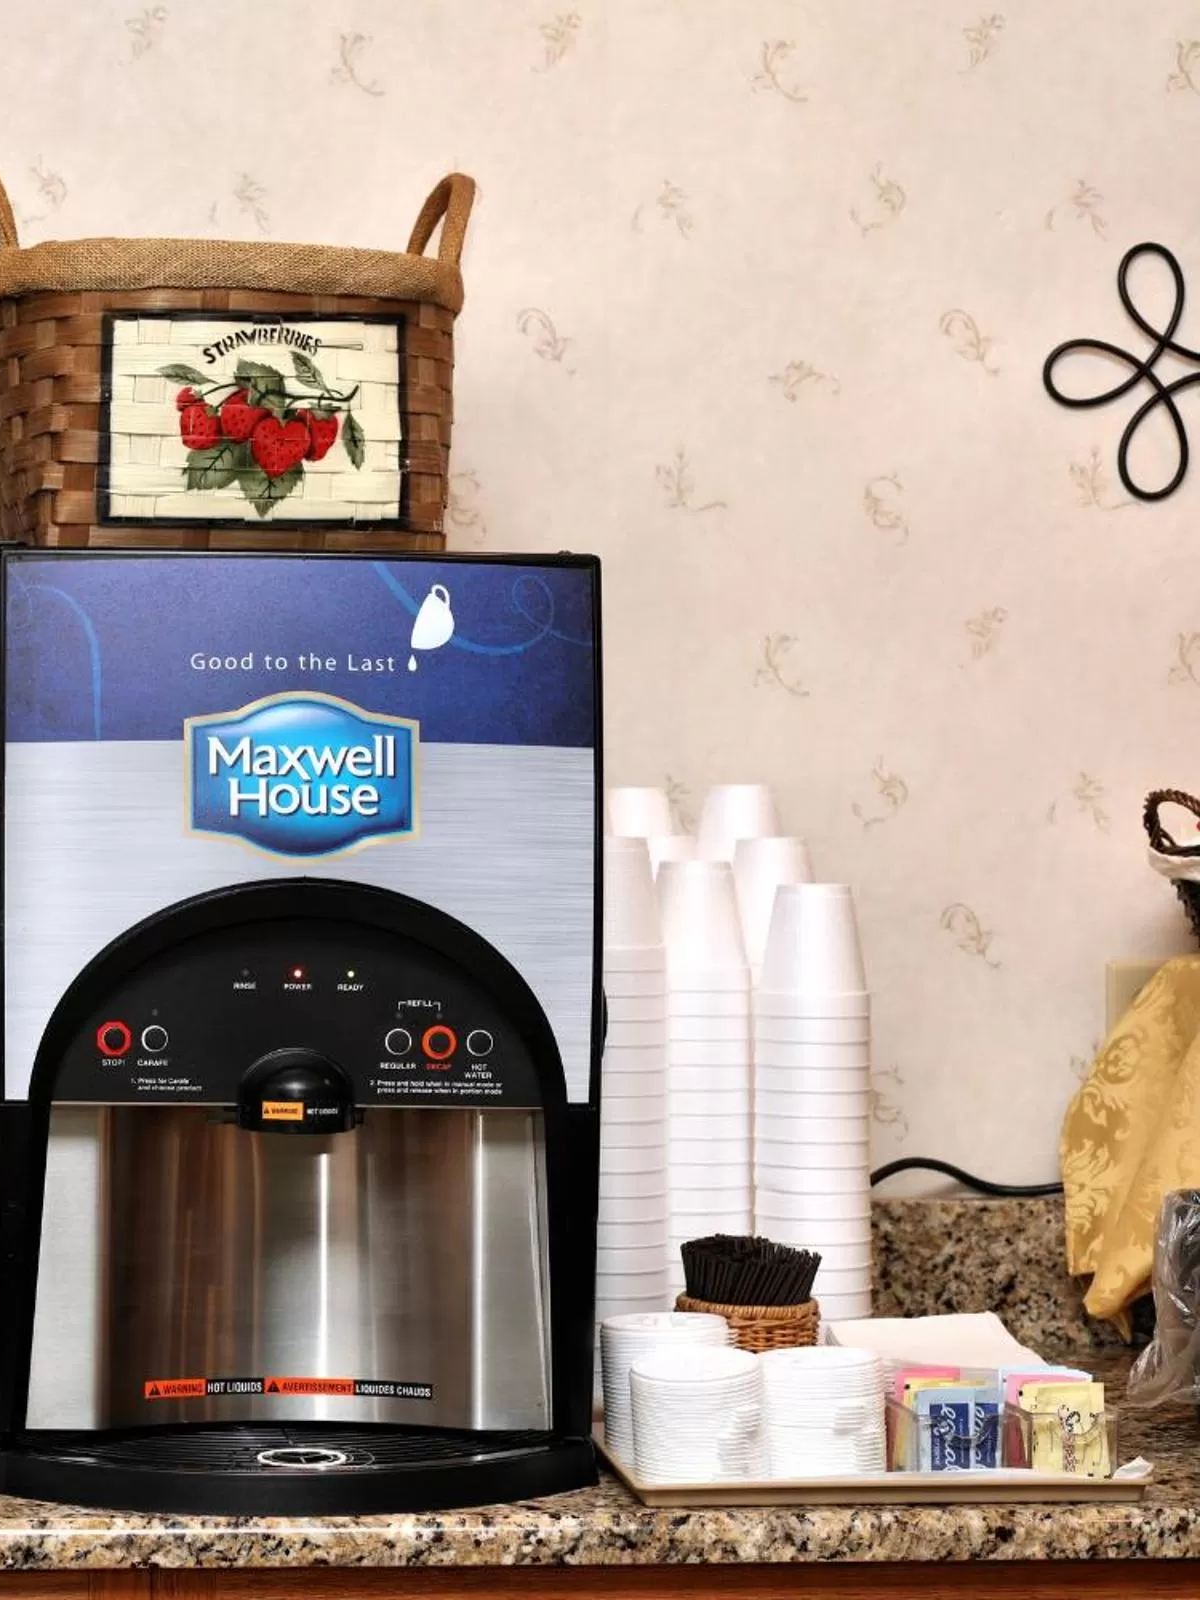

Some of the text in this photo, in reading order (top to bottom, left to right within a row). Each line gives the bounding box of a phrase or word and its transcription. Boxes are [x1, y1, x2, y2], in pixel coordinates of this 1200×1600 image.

[202, 326, 323, 364] STRAWBERRIES
[190, 652, 396, 672] Good to the Last
[207, 735, 396, 781] Maxwell
[227, 777, 380, 817] House
[283, 983, 313, 991] POWER
[337, 983, 364, 991] READY
[379, 1062, 417, 1070] REGULAR
[471, 1063, 488, 1071] HOT
[464, 1071, 493, 1079] WATER
[162, 1381, 432, 1398] WARNING HOT LIQUIDS AVERTISSEMENT LIQUIDES CHAUDS
